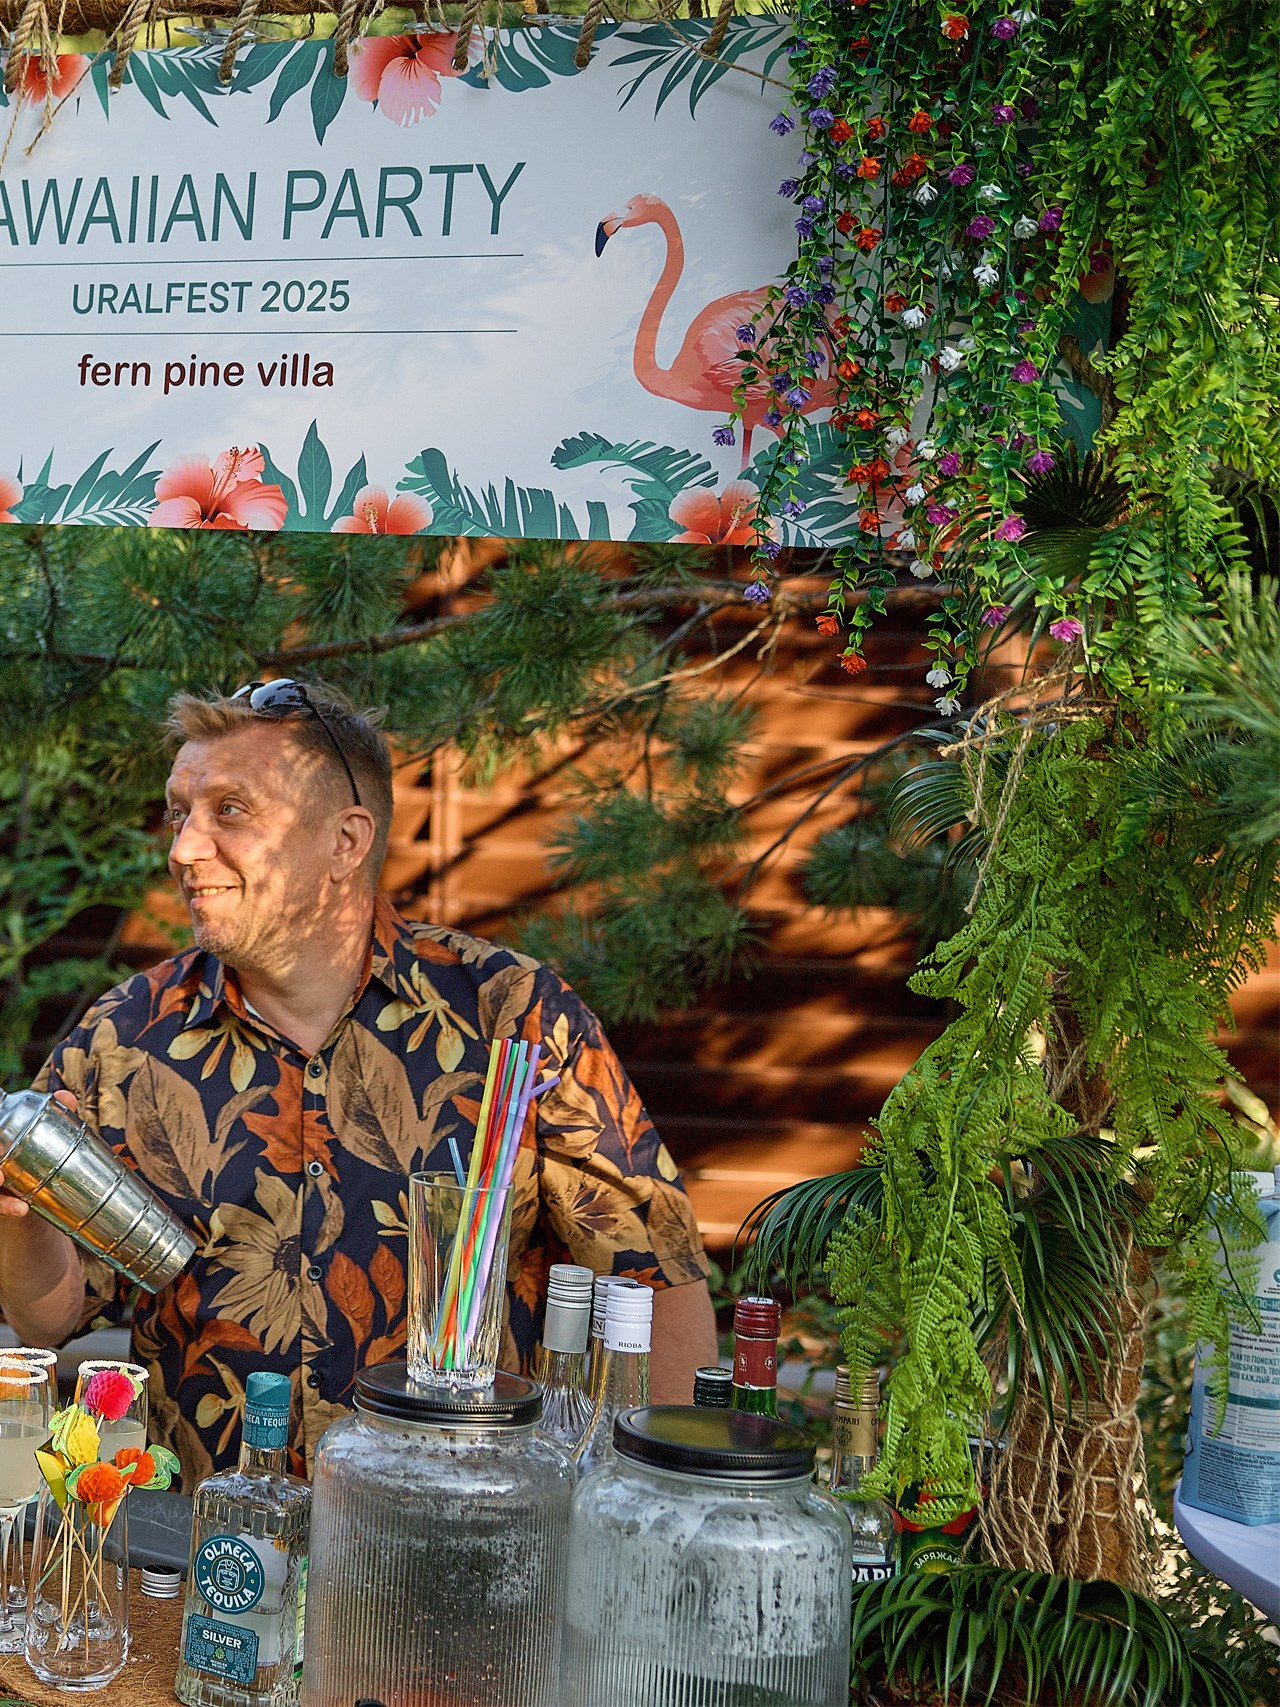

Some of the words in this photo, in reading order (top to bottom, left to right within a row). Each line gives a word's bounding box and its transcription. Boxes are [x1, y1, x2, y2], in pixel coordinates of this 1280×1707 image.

[281, 162, 526, 240] PARTY
[72, 281, 253, 315] URALFEST
[260, 279, 350, 313] 2025
[78, 353, 151, 388] fern
[163, 353, 245, 395] pine
[257, 353, 335, 388] villa
[245, 1413, 260, 1425] MECA
[263, 1416, 288, 1428] TEQUIL
[204, 1541, 256, 1573] OLMECA
[201, 1576, 256, 1608] TEQUILA
[202, 1629, 242, 1649] SILVER
